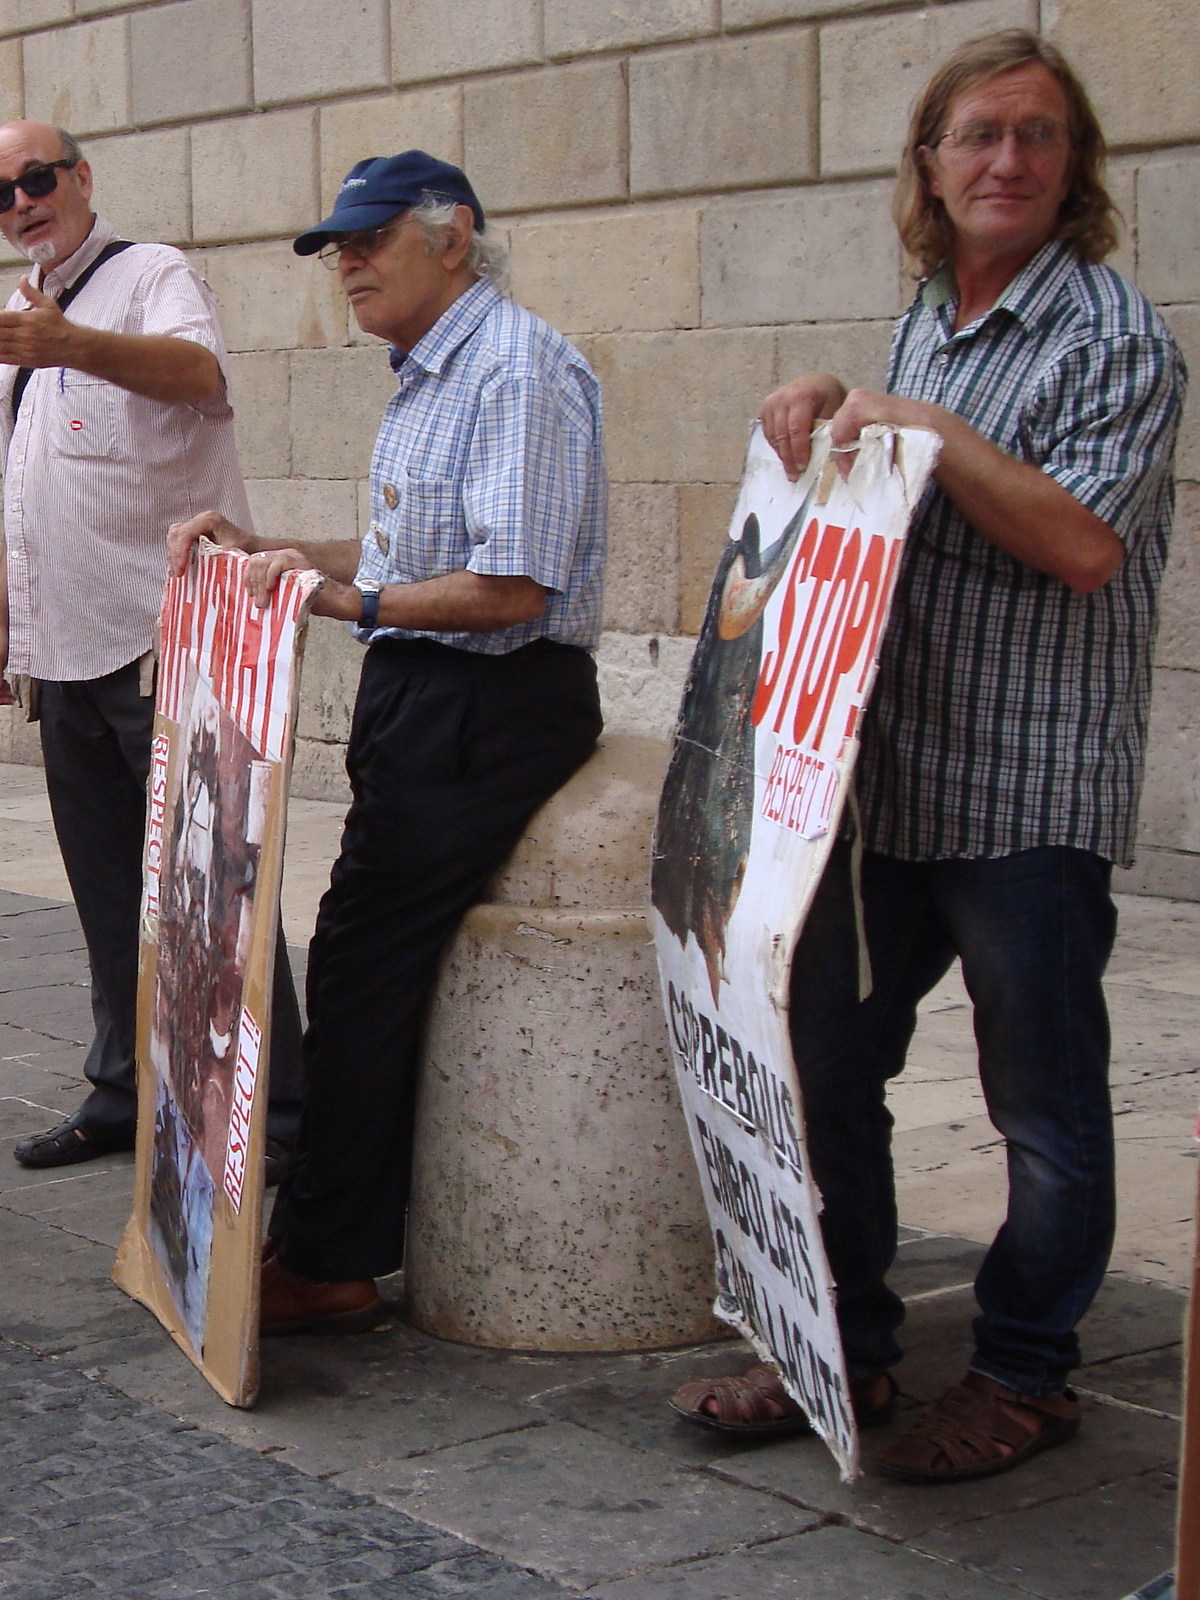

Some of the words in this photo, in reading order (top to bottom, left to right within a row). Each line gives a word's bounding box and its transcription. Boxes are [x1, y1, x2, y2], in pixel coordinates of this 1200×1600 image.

[147, 735, 170, 877] RESPECT
[762, 744, 825, 833] RESPECT
[224, 1051, 256, 1207] RESPECT
[696, 1114, 819, 1317] EMBOLATS
